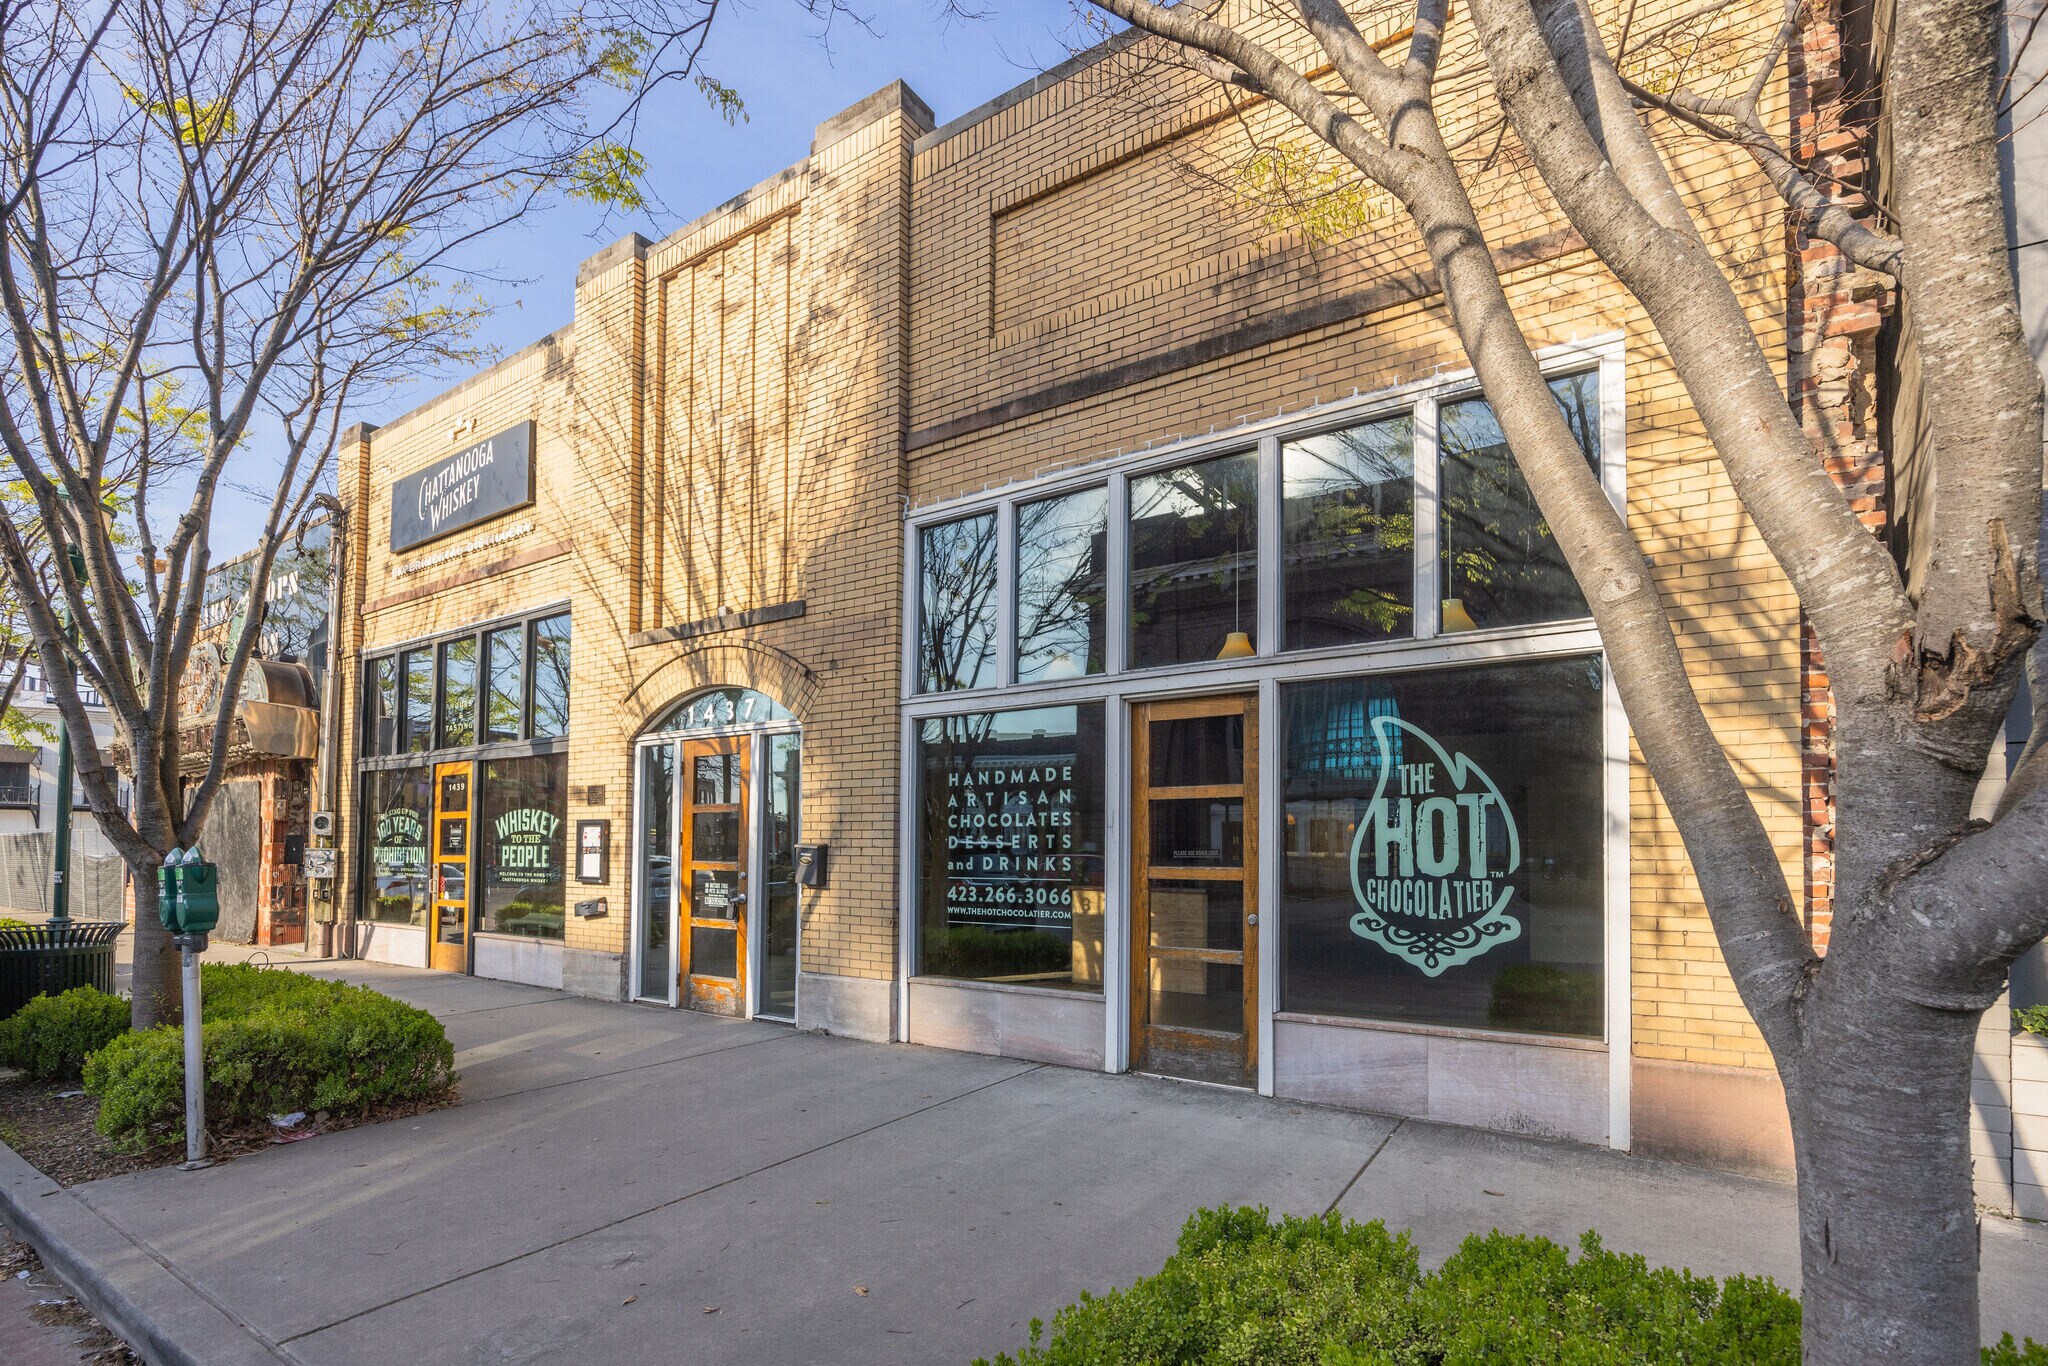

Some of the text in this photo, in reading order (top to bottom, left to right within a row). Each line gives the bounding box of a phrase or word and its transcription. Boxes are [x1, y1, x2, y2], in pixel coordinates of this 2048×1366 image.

[418, 440, 494, 520] CHATTANOOGA
[430, 474, 480, 532] WHISKEY
[688, 698, 754, 724] 1437
[446, 722, 472, 732] TASTING
[948, 766, 1072, 786] HANDMADE
[1398, 763, 1434, 795] THE
[448, 782, 465, 792] 1439
[948, 789, 1071, 808] ARTISAN
[377, 816, 423, 842] 100 YEARS
[495, 808, 560, 840] WHISKEY
[948, 812, 1072, 828] CHOCOLATES
[394, 836, 404, 844] OF
[511, 834, 541, 844] TO THE
[948, 834, 1072, 850] DESSERTS
[1374, 792, 1495, 878] HOT
[374, 846, 426, 864] PROHIBITION
[502, 845, 550, 868] PEOPLE
[948, 856, 1072, 872] and DRINKS
[947, 886, 1071, 905] 423.266.3066
[1366, 878, 1493, 920] CHOCOLATIER
[947, 906, 1072, 920] WWW.THEHOTCHOCOLATIER.COM
